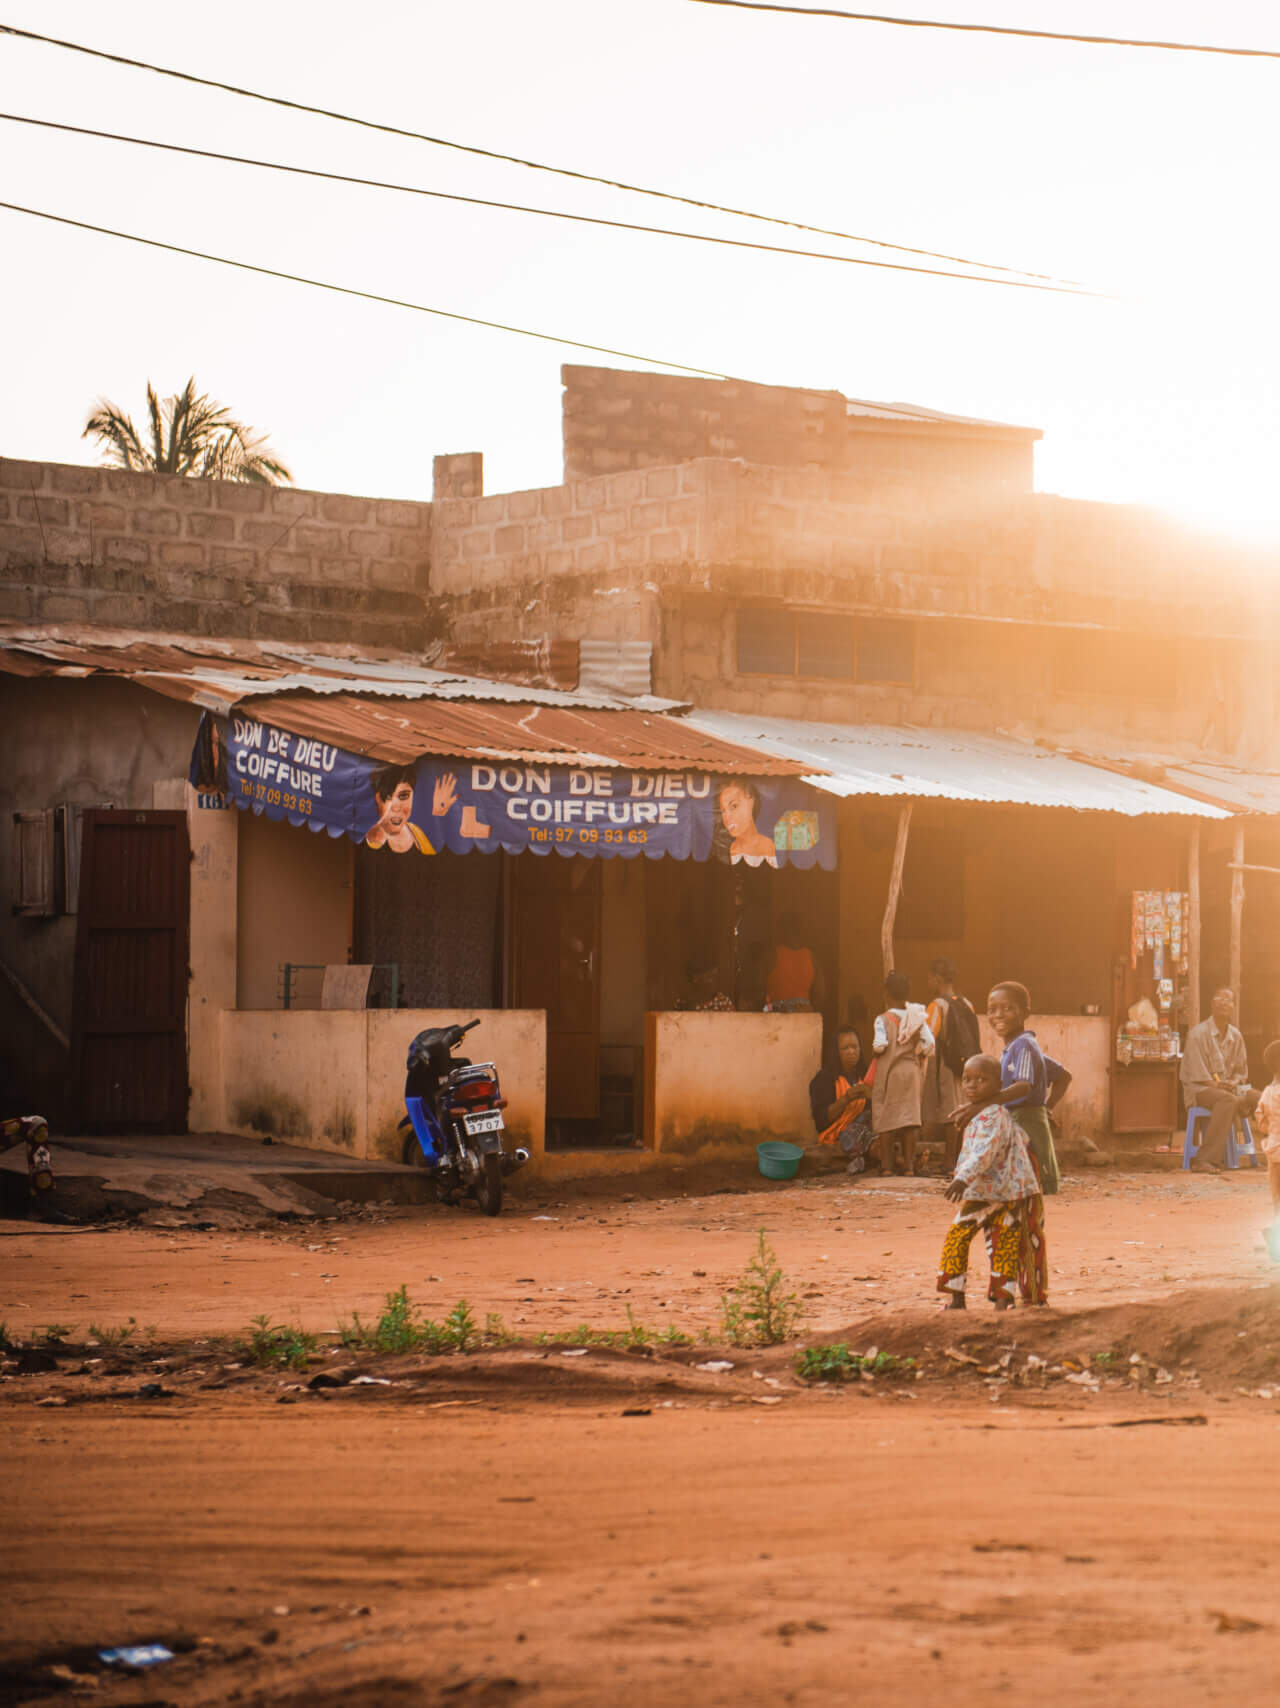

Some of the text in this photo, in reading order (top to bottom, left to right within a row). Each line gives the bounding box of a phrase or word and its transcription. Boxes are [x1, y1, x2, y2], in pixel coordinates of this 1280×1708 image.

[234, 719, 338, 773] DON DE DIEU
[235, 749, 323, 798] COIFFURE
[471, 765, 711, 799] DON DE DIEU
[267, 788, 281, 806] 09
[282, 793, 297, 811] 93
[298, 797, 313, 815] 63
[507, 797, 679, 825] COIFFURE
[555, 827, 575, 842] 97
[579, 828, 599, 843] 09
[604, 829, 624, 843] 93
[628, 829, 648, 844] 63
